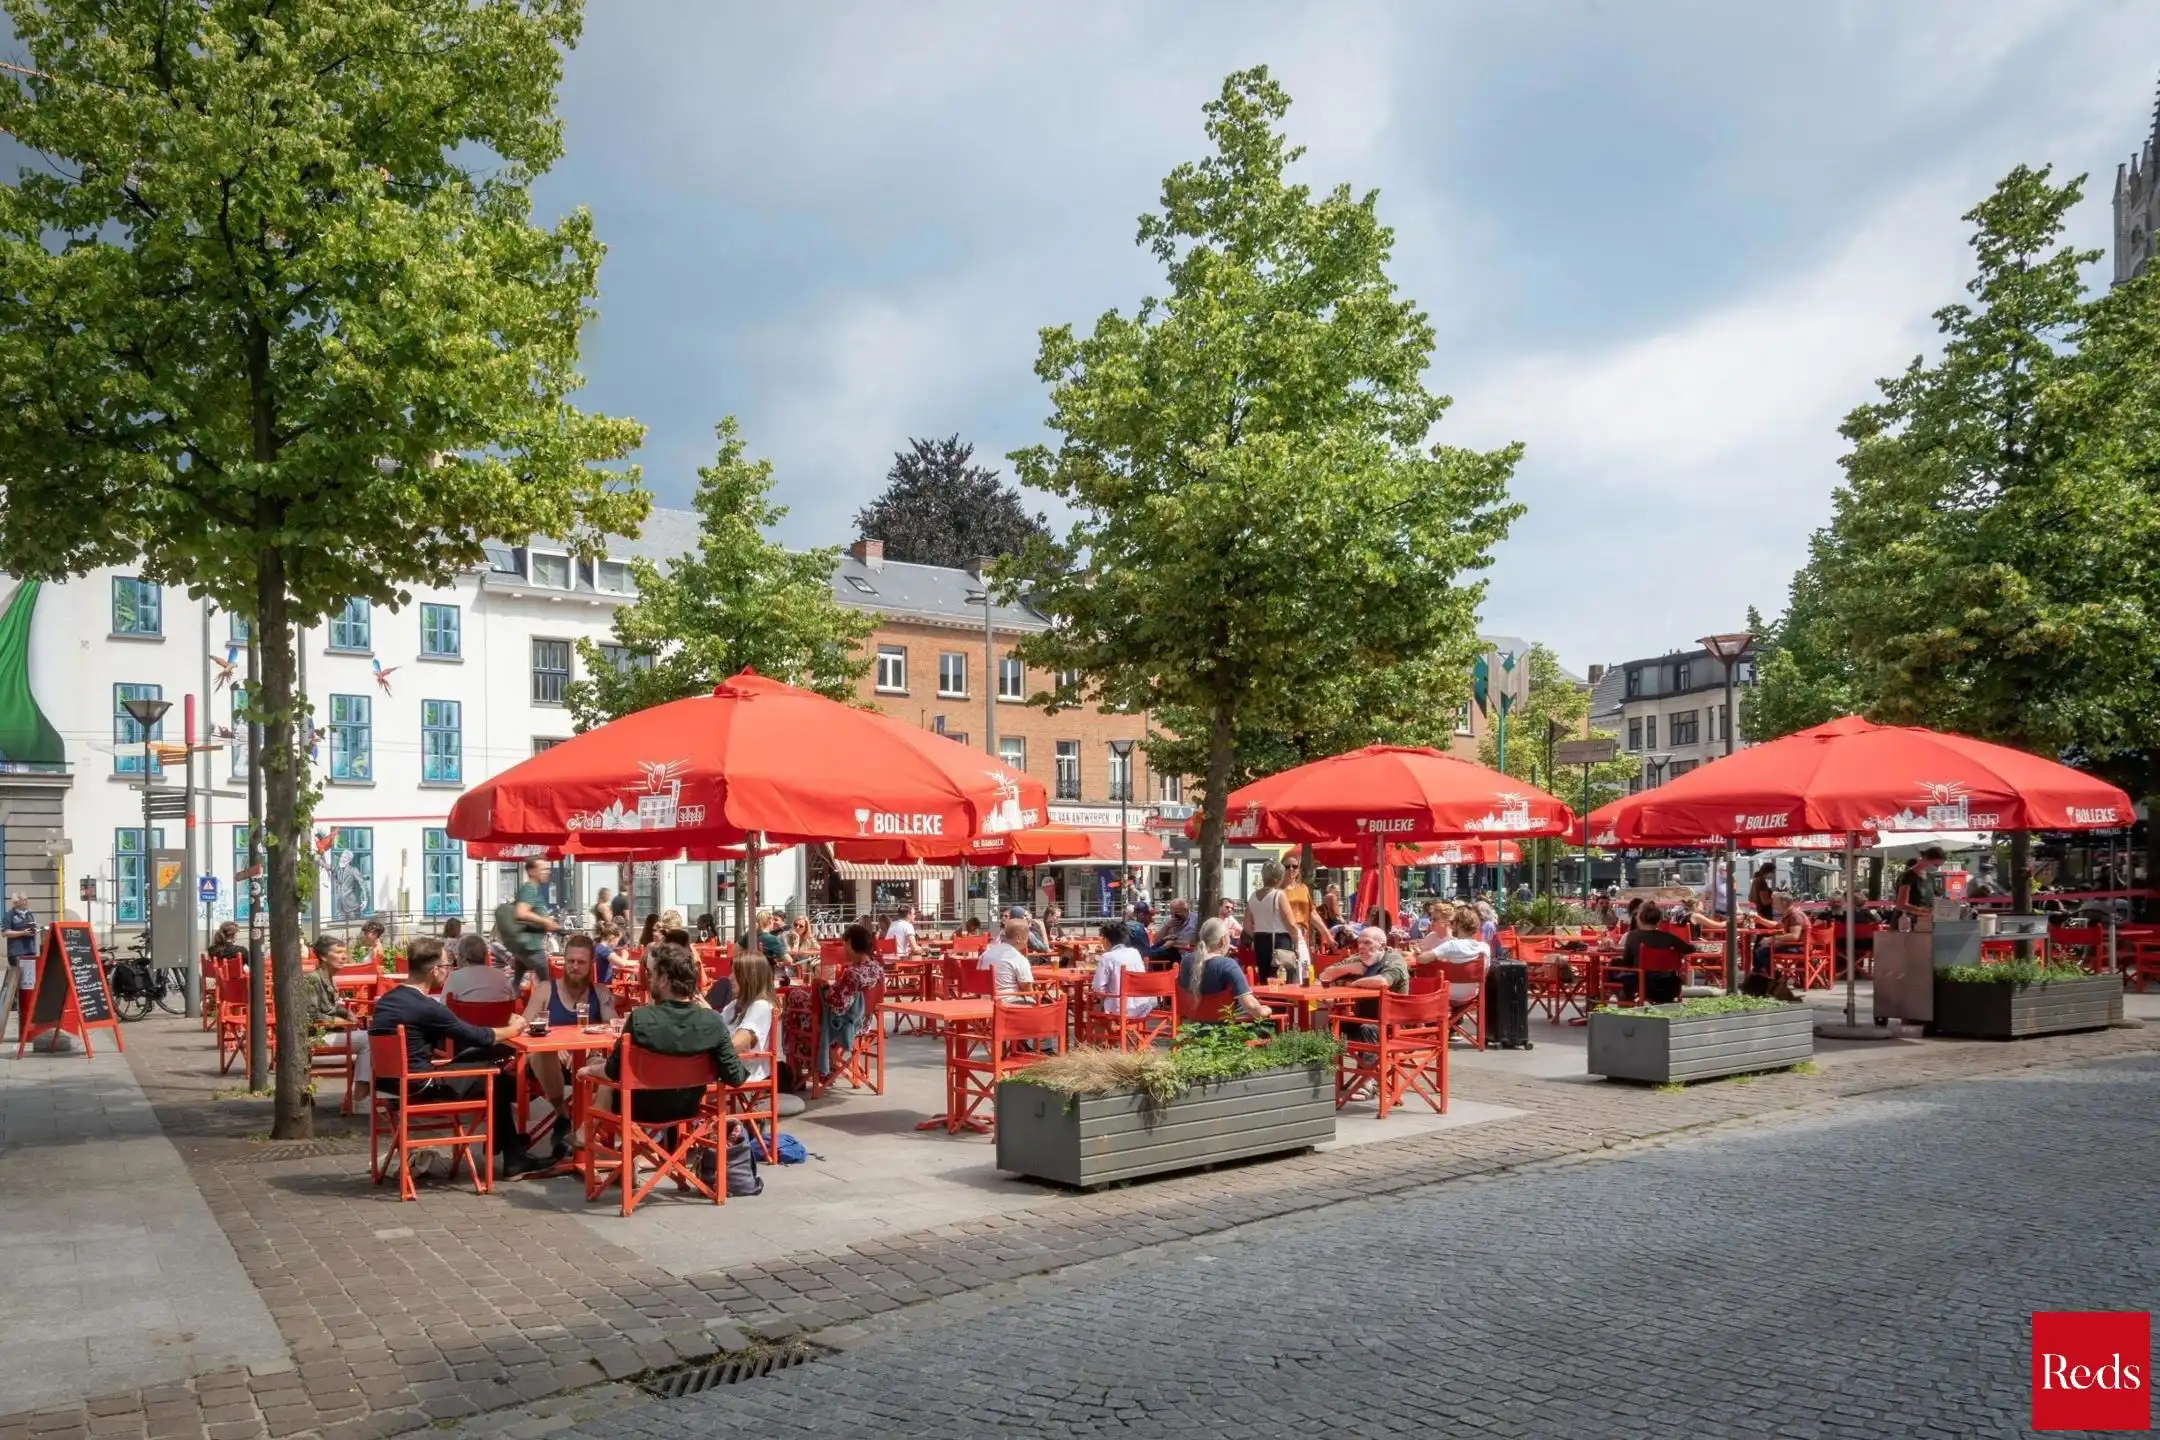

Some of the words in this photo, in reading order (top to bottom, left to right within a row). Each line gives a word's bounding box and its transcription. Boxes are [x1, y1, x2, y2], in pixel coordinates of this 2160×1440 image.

[1072, 812, 1110, 824] ANTWERPEN
[1745, 813, 1789, 830] BOLLEKE
[2075, 808, 2118, 823] BOLLEKE
[873, 813, 943, 835] BOLLEKE
[1369, 818, 1415, 832] BOLLEKE
